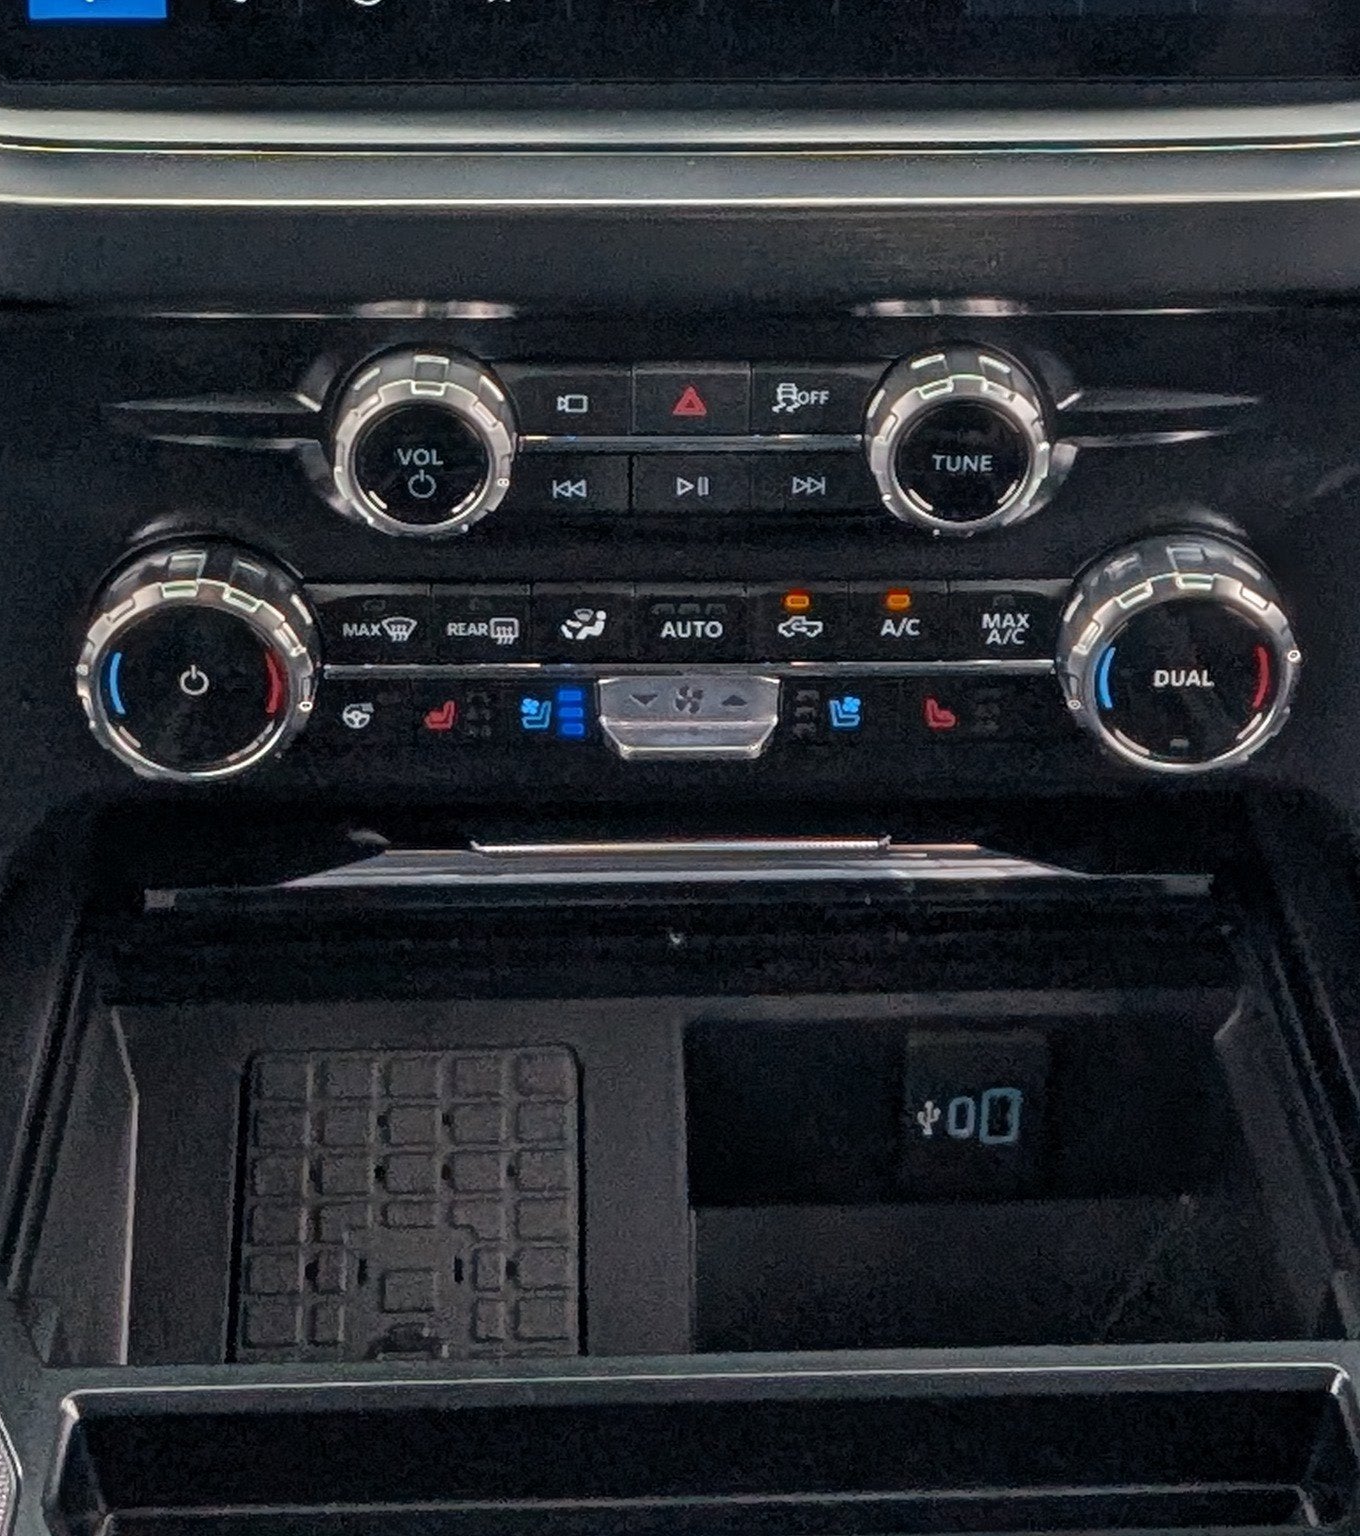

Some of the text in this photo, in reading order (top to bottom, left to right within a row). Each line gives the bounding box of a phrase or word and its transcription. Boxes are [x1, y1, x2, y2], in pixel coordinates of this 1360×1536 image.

[796, 390, 829, 406] OFF
[395, 447, 443, 466] VOL
[932, 454, 992, 473] TUNE
[343, 623, 381, 637] MAX
[447, 622, 487, 636] REAR
[661, 621, 723, 639] AUTO
[881, 618, 920, 636] A/C
[982, 614, 1030, 630] MAX
[986, 628, 1025, 646] A/C
[1153, 670, 1215, 688] DUAL
